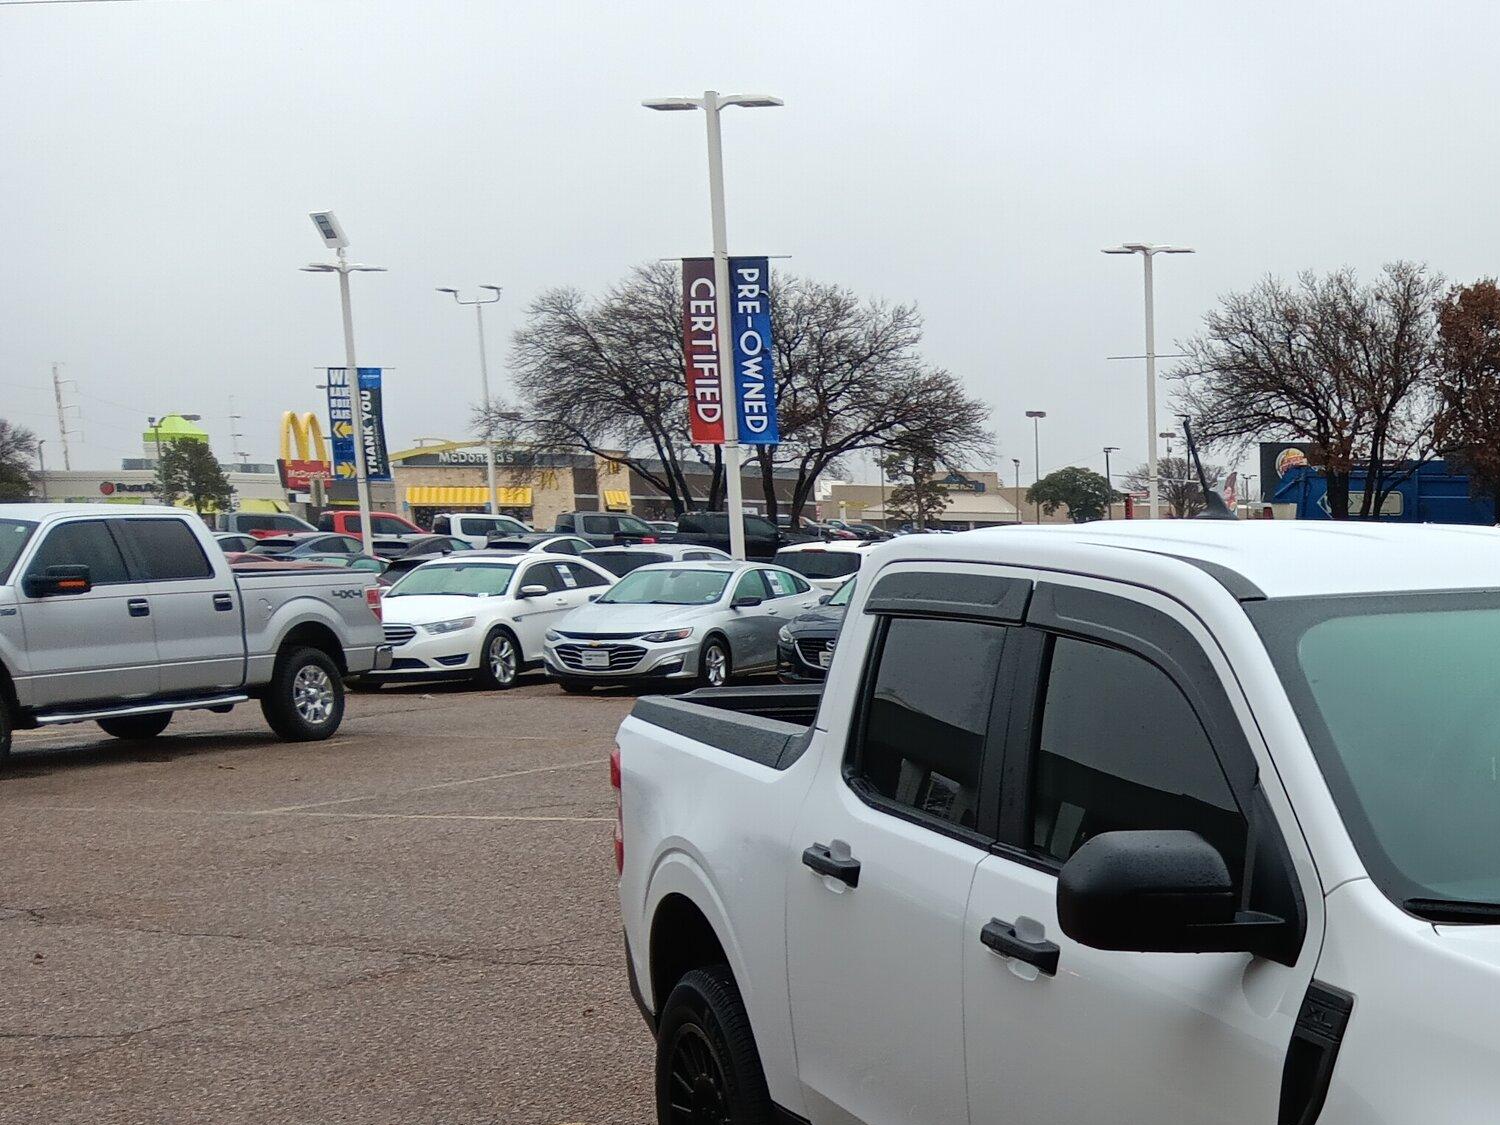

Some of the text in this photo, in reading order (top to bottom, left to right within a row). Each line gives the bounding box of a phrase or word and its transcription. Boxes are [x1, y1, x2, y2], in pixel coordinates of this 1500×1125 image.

[690, 277, 721, 423] CERTIFIED
[737, 268, 768, 433] PRE-OWNED
[360, 390, 372, 421] YOU
[363, 426, 378, 474] THANK
